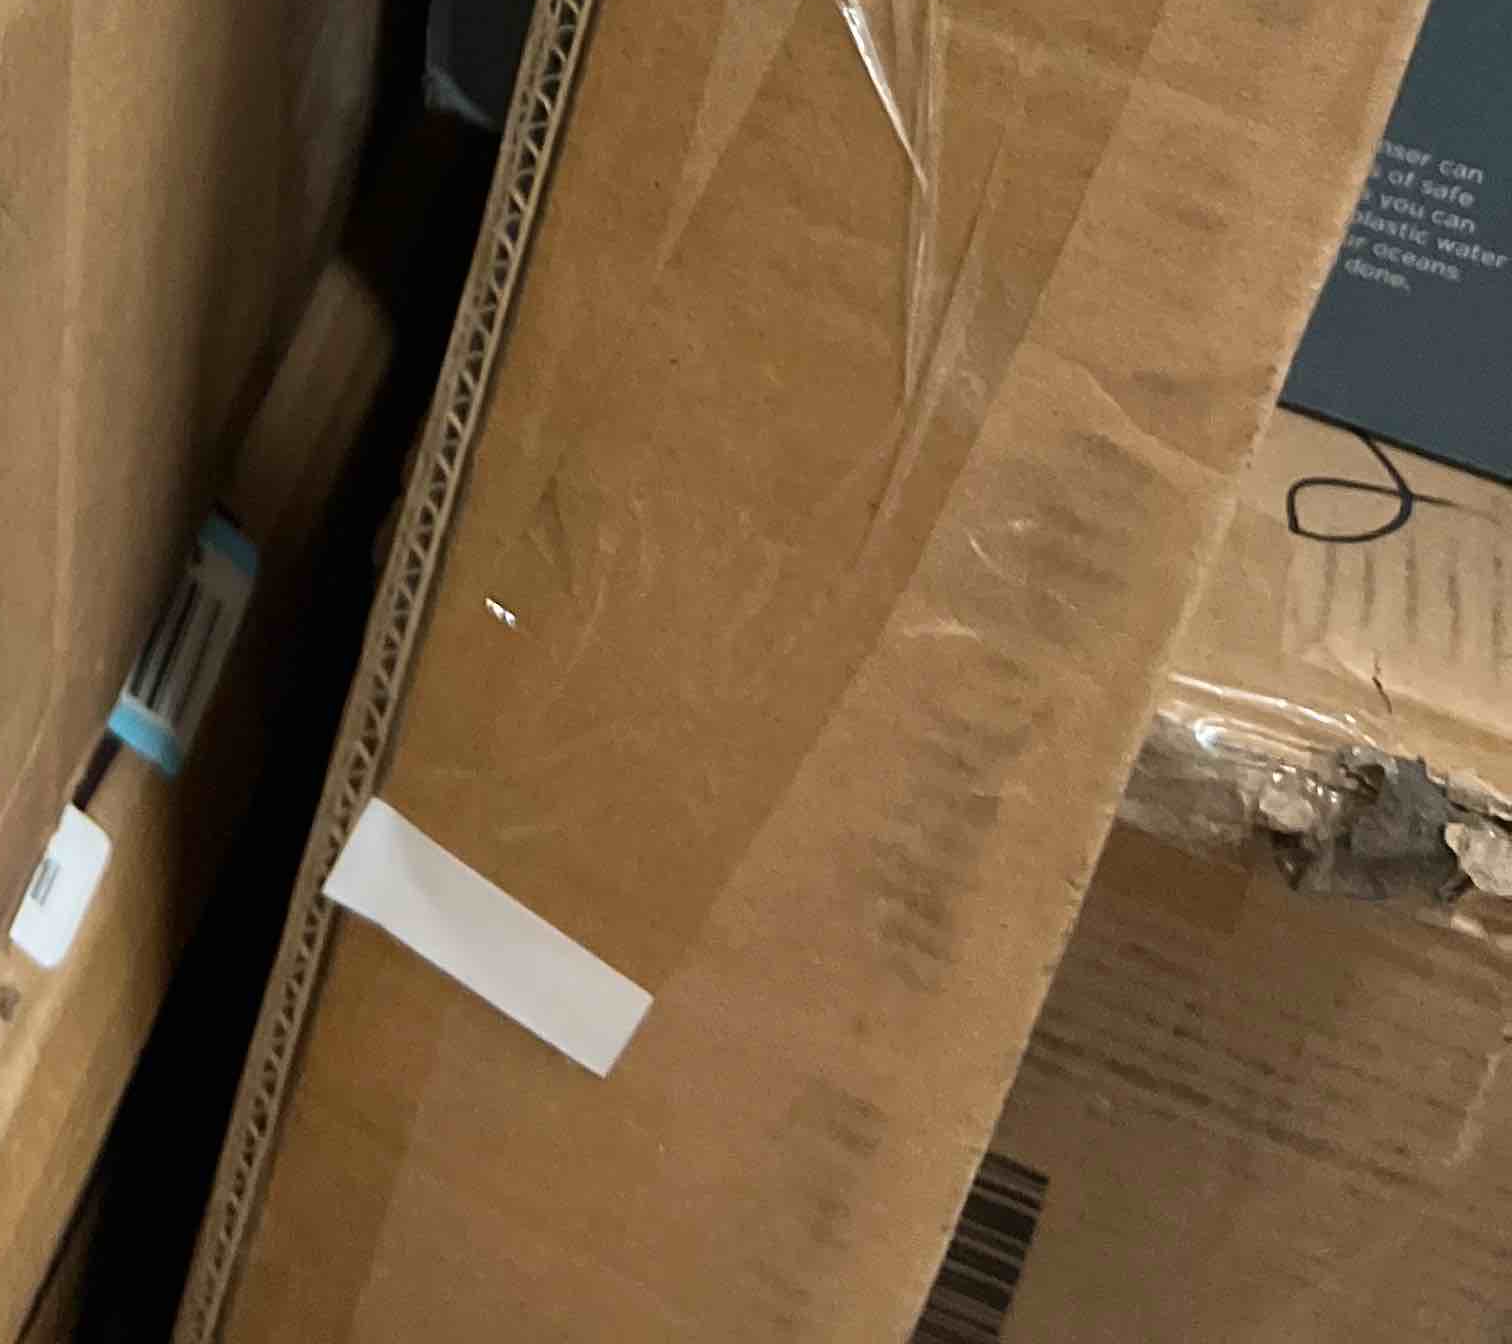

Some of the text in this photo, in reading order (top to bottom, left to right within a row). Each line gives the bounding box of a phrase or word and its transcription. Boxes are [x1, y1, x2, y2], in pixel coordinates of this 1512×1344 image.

[1439, 159, 1483, 185] can
[1421, 179, 1475, 208] safe
[1381, 192, 1476, 234] you can
[1372, 241, 1461, 283] oceans
[1436, 237, 1509, 269] water
